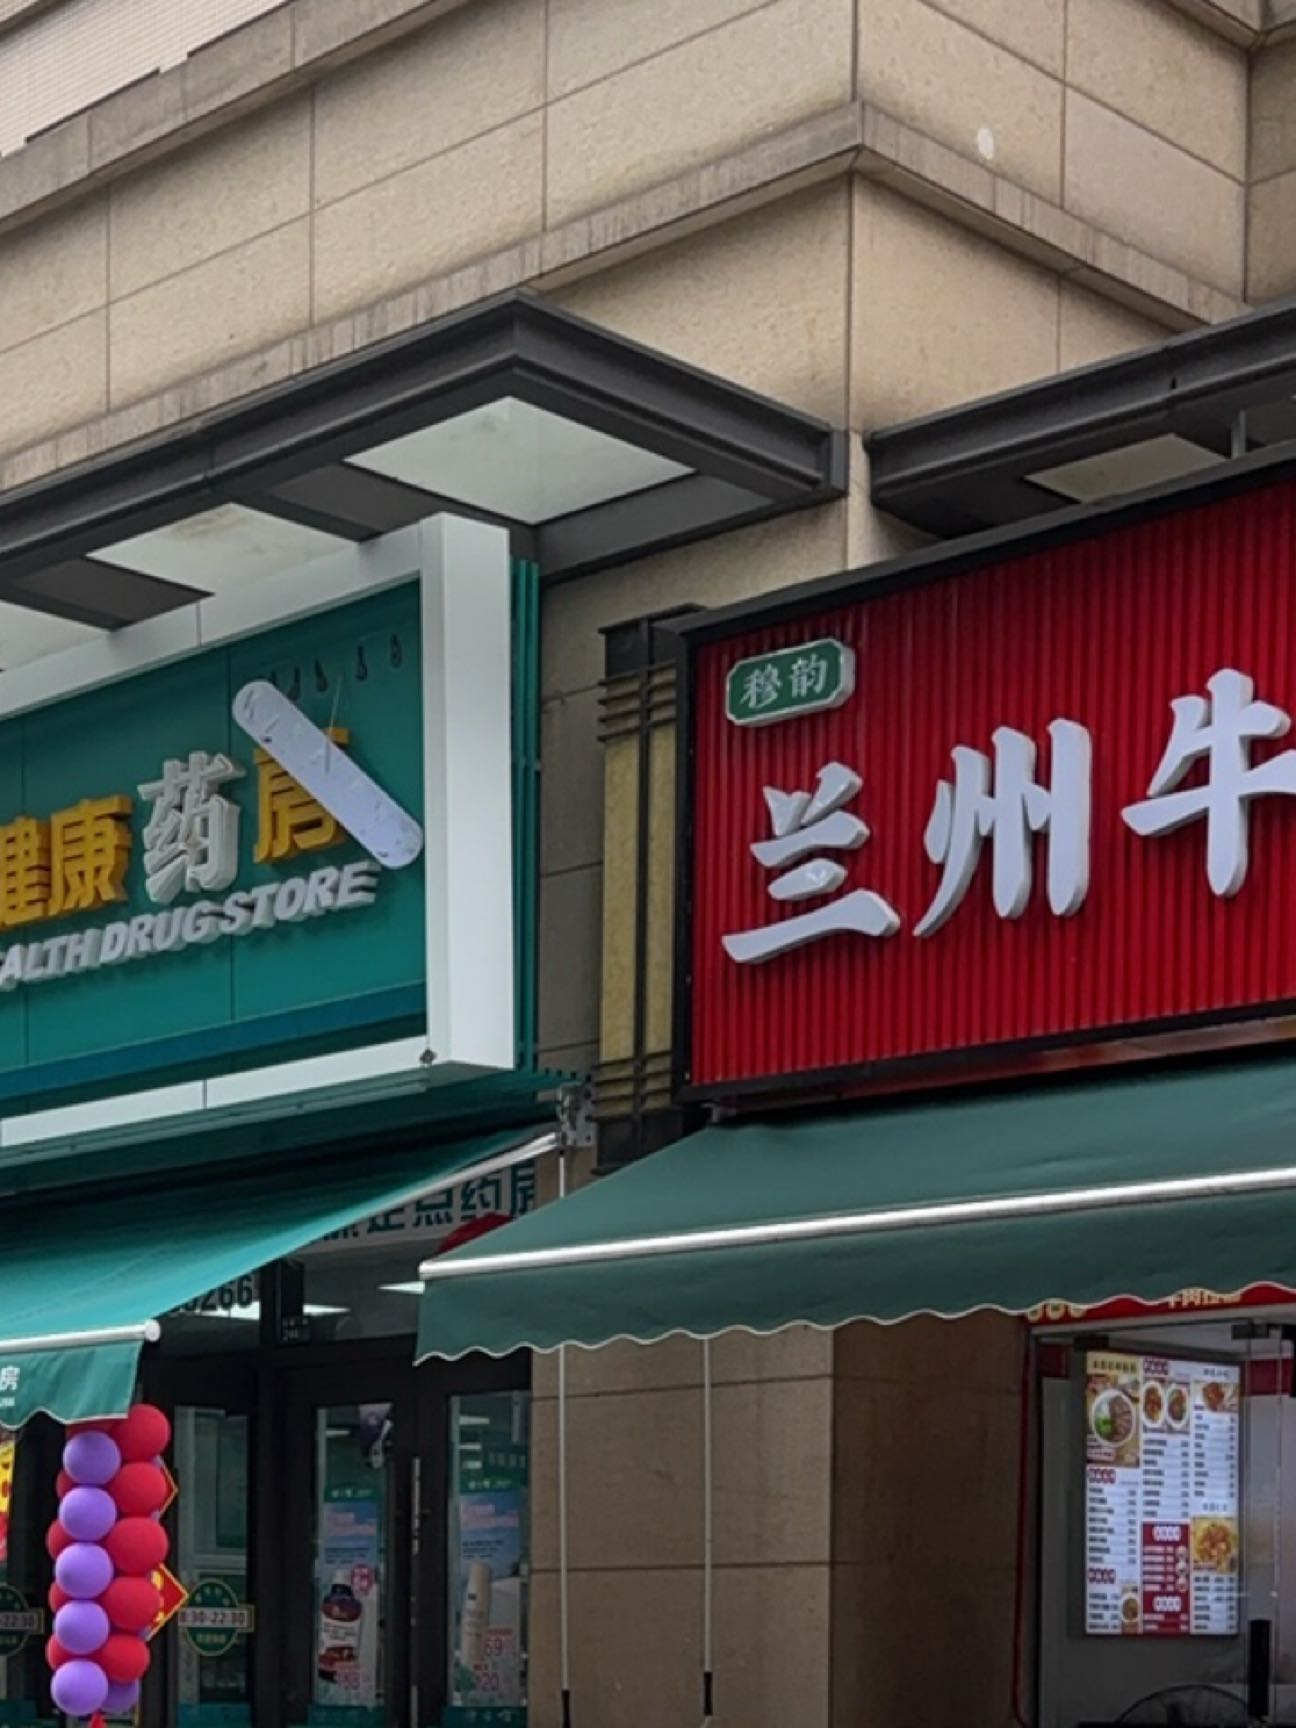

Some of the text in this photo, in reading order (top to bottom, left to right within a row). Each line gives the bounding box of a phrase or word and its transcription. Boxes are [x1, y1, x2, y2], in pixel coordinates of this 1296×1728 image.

[739, 652, 831, 711] 穆韵
[721, 667, 1296, 964] 兰州牛
